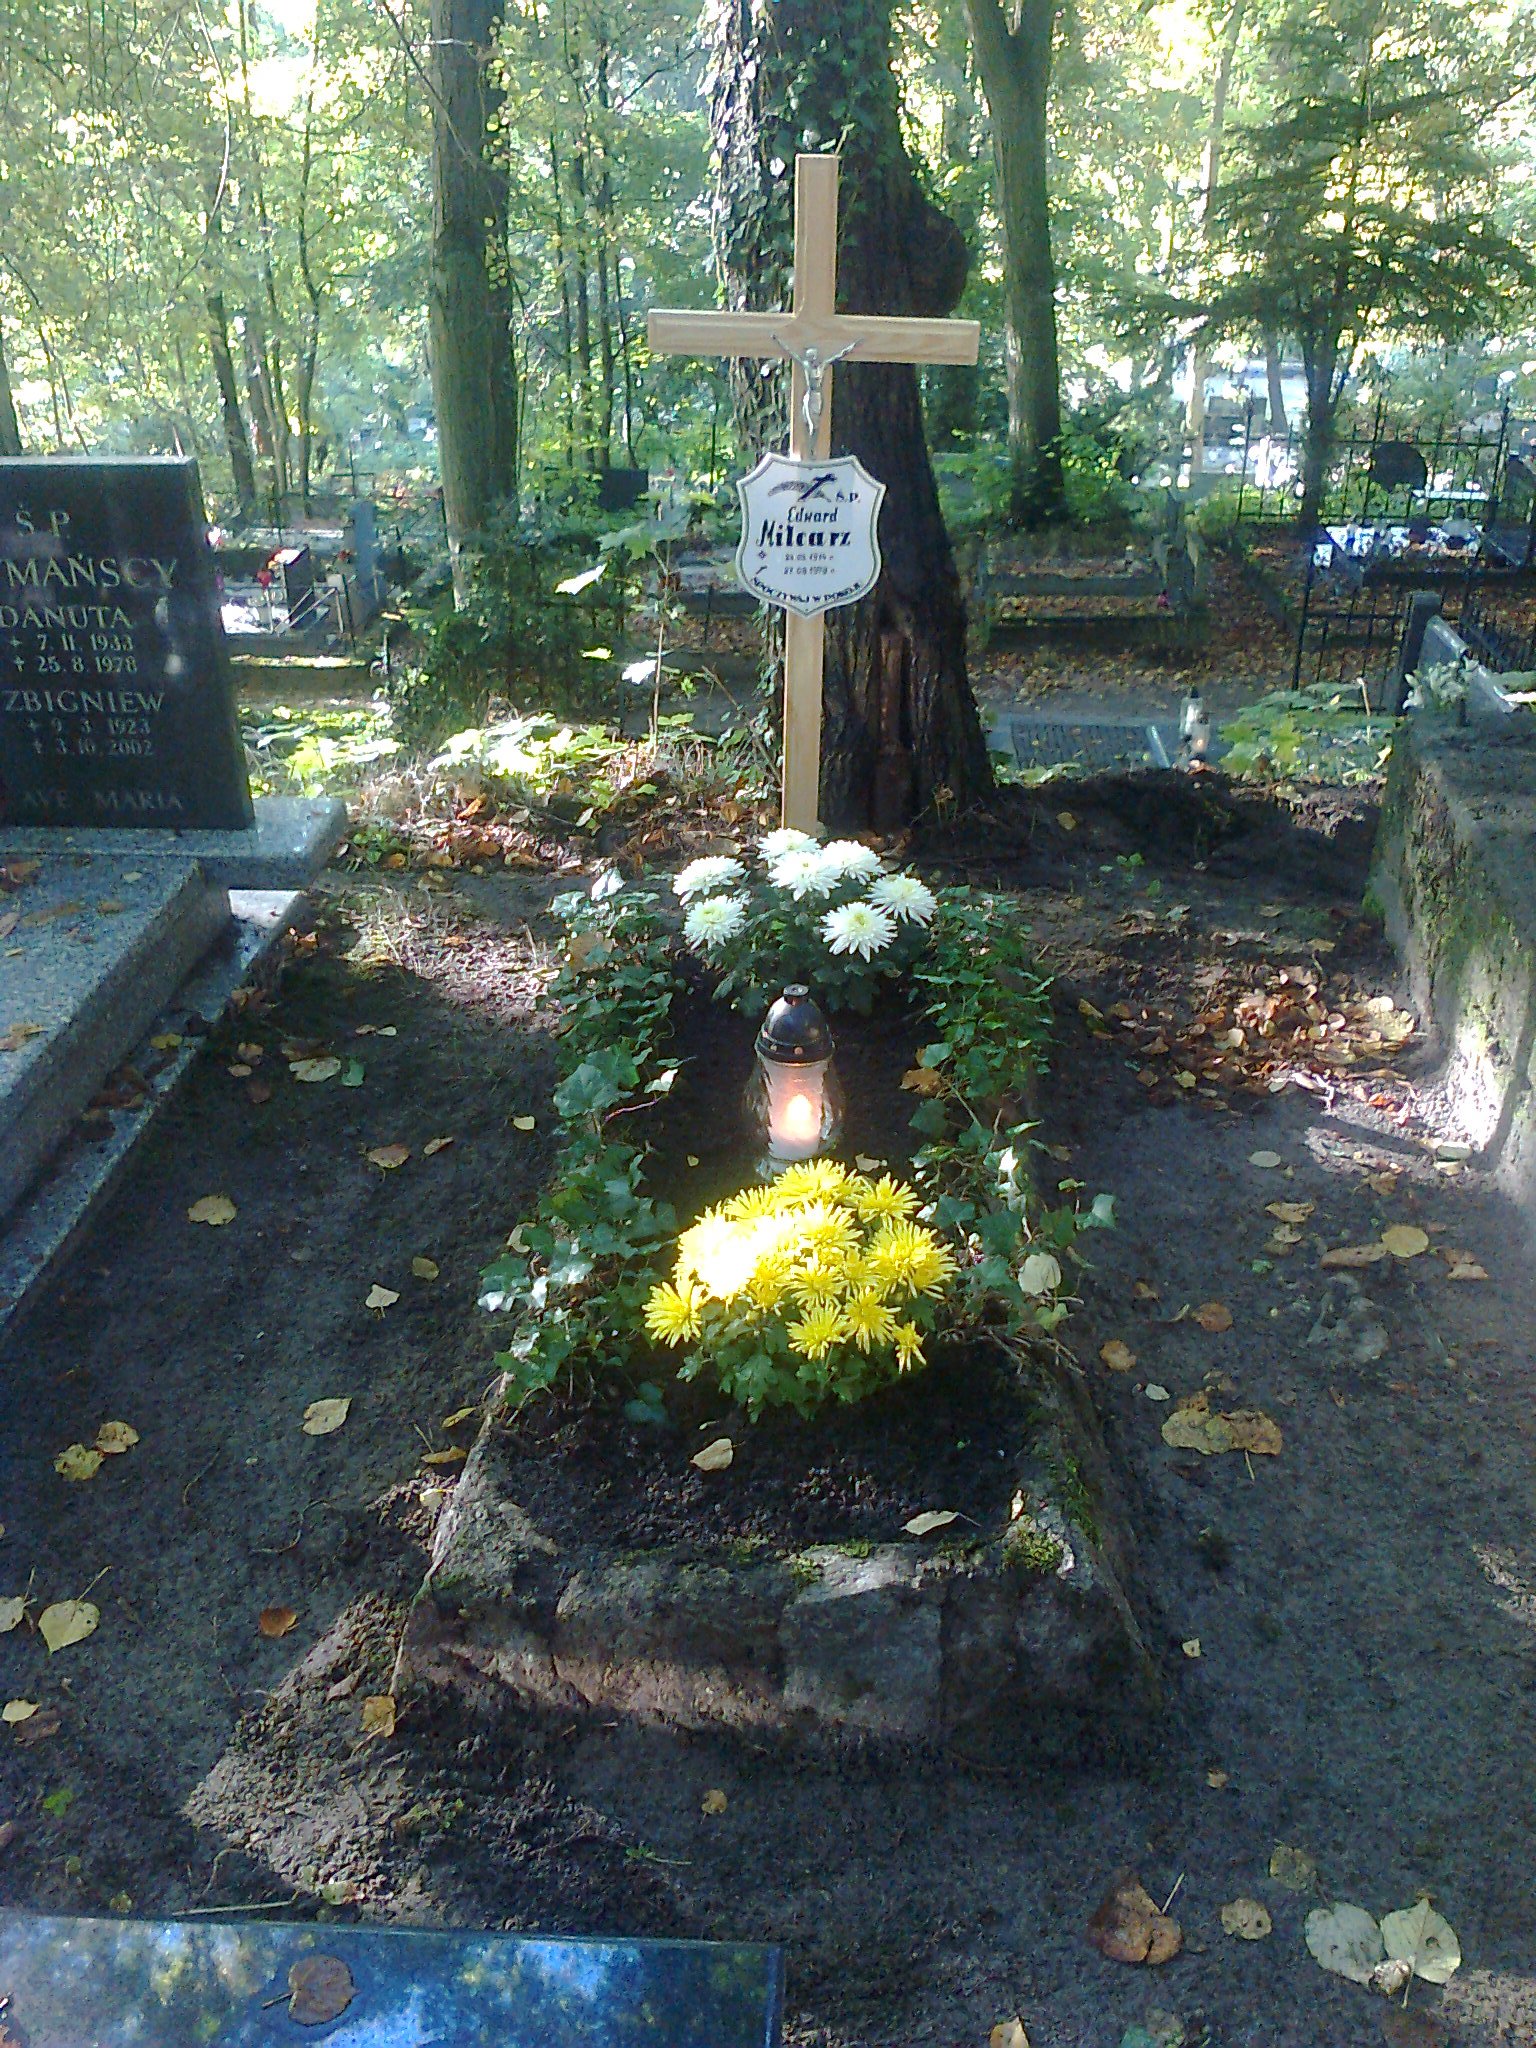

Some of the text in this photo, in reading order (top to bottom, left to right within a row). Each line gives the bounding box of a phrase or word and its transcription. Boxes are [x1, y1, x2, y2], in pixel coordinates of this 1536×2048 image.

[787, 506, 839, 524] Edward
[756, 519, 851, 548] Milcarz
[0, 553, 178, 588] MAŃSCY
[0, 605, 132, 630] DANUTA
[95, 655, 138, 673] 1978
[2, 688, 166, 713] ZBIGNIEW
[95, 789, 183, 810] MARIA
